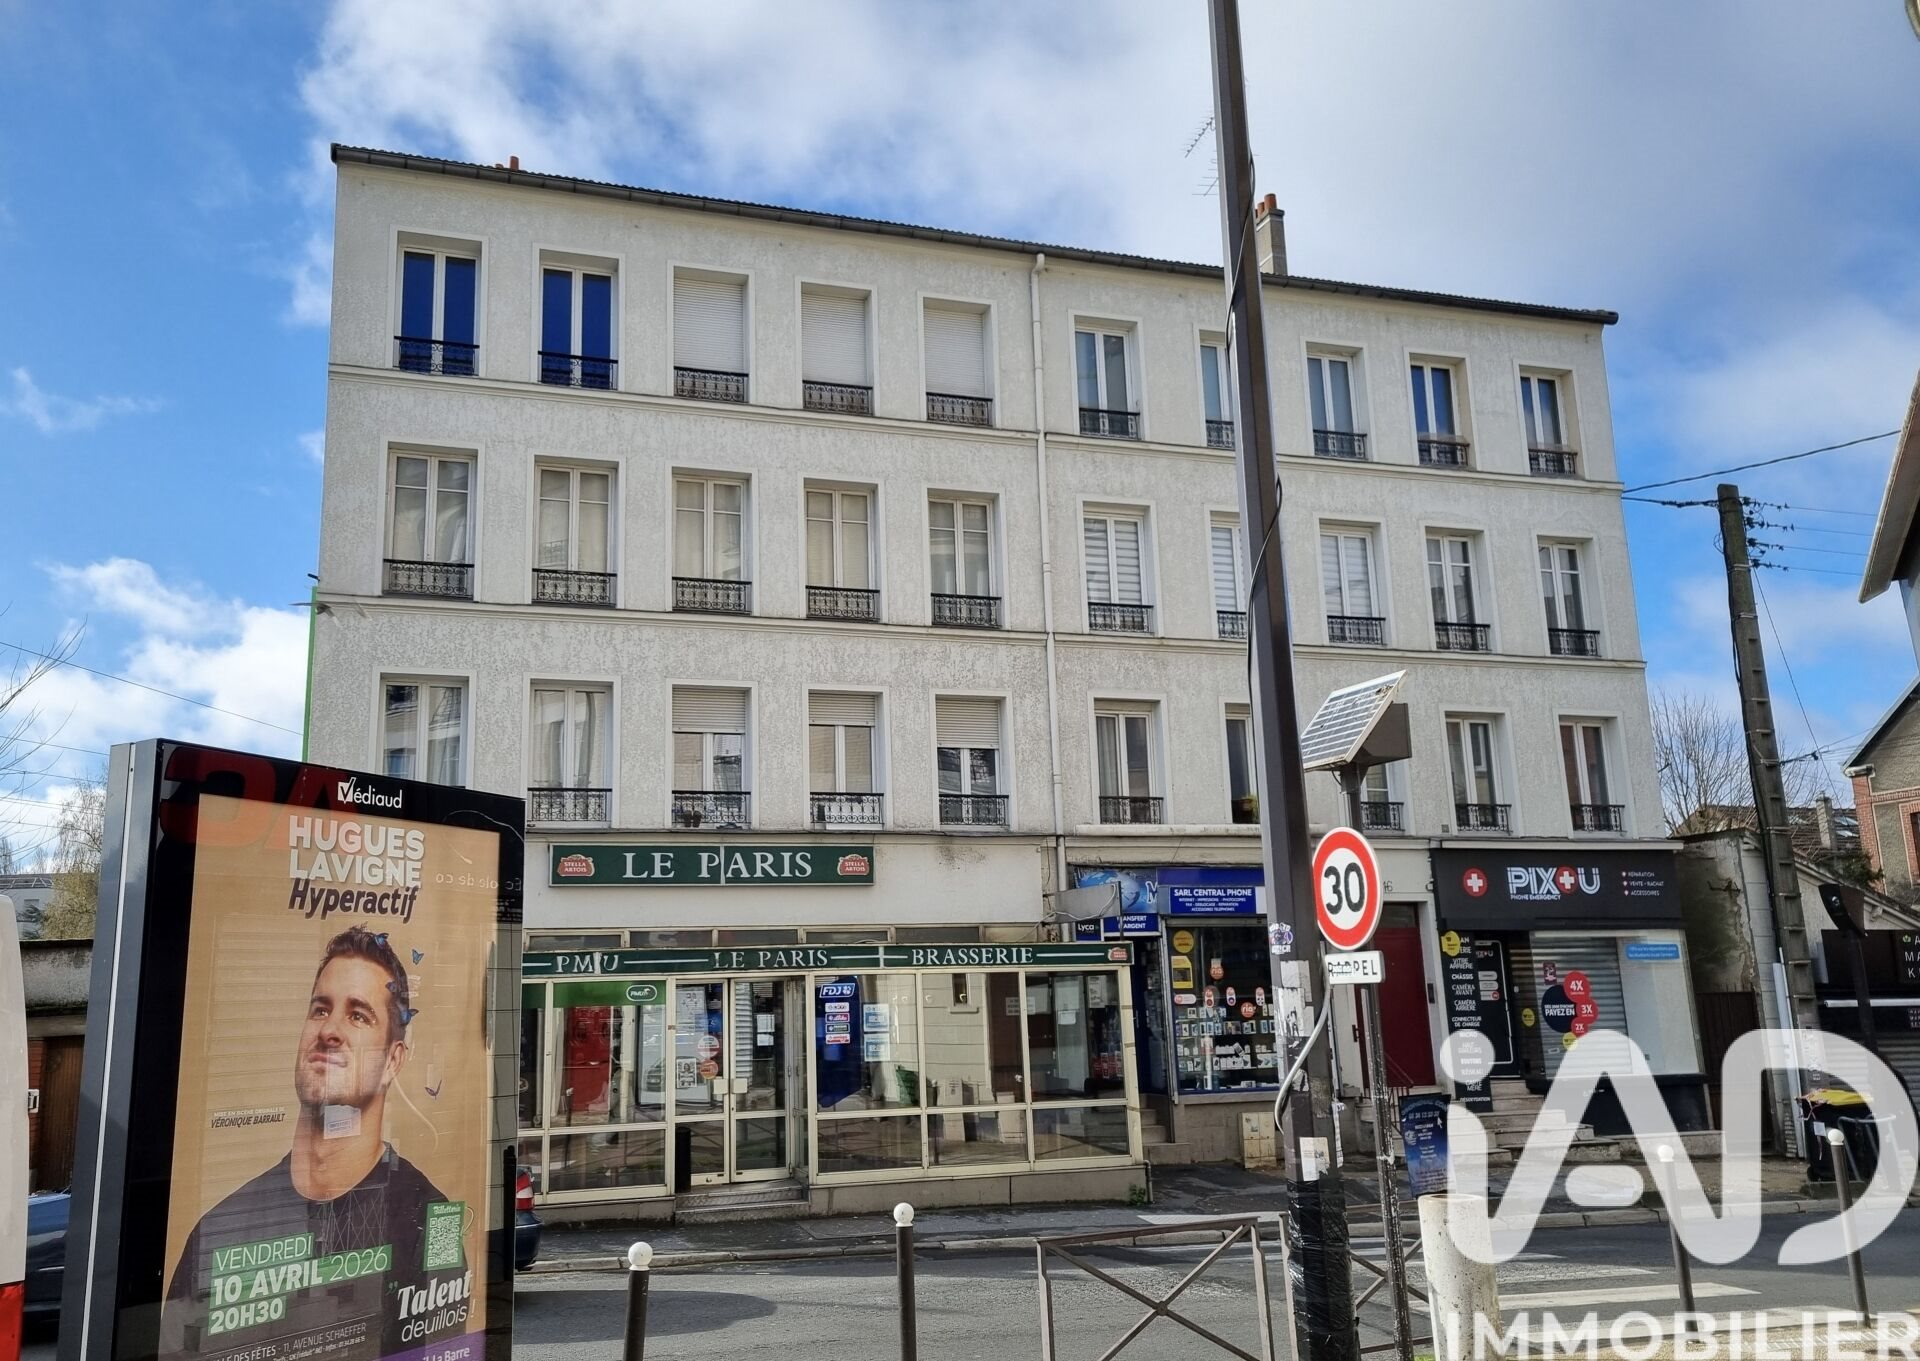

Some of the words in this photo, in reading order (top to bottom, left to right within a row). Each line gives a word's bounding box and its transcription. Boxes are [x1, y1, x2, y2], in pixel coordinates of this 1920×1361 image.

[288, 815, 425, 860] HUGUES
[289, 848, 422, 888] LAVIGNE
[622, 851, 675, 879] LE
[698, 851, 812, 879] PARIS
[288, 877, 420, 924] Hyperactif
[1324, 862, 1366, 915] 30
[1529, 893, 1562, 901] EMERGENCY
[1077, 923, 1095, 932] Lyca
[556, 953, 619, 974] PMU
[713, 950, 745, 969] LE
[757, 949, 828, 969] PARIS
[911, 947, 1034, 966] BRASSERIE
[822, 986, 842, 996] FDJ
[1569, 980, 1584, 991] 4X
[1545, 1008, 1566, 1017] PAYEZ
[1566, 1008, 1575, 1016] EN
[1581, 1004, 1593, 1014] 3X
[1575, 1023, 1585, 1031] 2X
[211, 1115, 252, 1129] VÉRONIQUE
[253, 1113, 286, 1126] BARRAULT
[215, 1235, 312, 1271] VENDREDI
[213, 1275, 243, 1306] 10
[250, 1259, 323, 1299] AVRIL
[329, 1246, 388, 1281] 2026
[397, 1270, 473, 1320] Talent
[210, 1298, 283, 1334] 20H30
[401, 1304, 468, 1342] deuillois
[251, 1344, 276, 1361] FÊTES
[293, 1333, 324, 1350] AVENUE
[325, 1322, 366, 1343] SCHAEFFER
[444, 1347, 470, 1361] Barre
